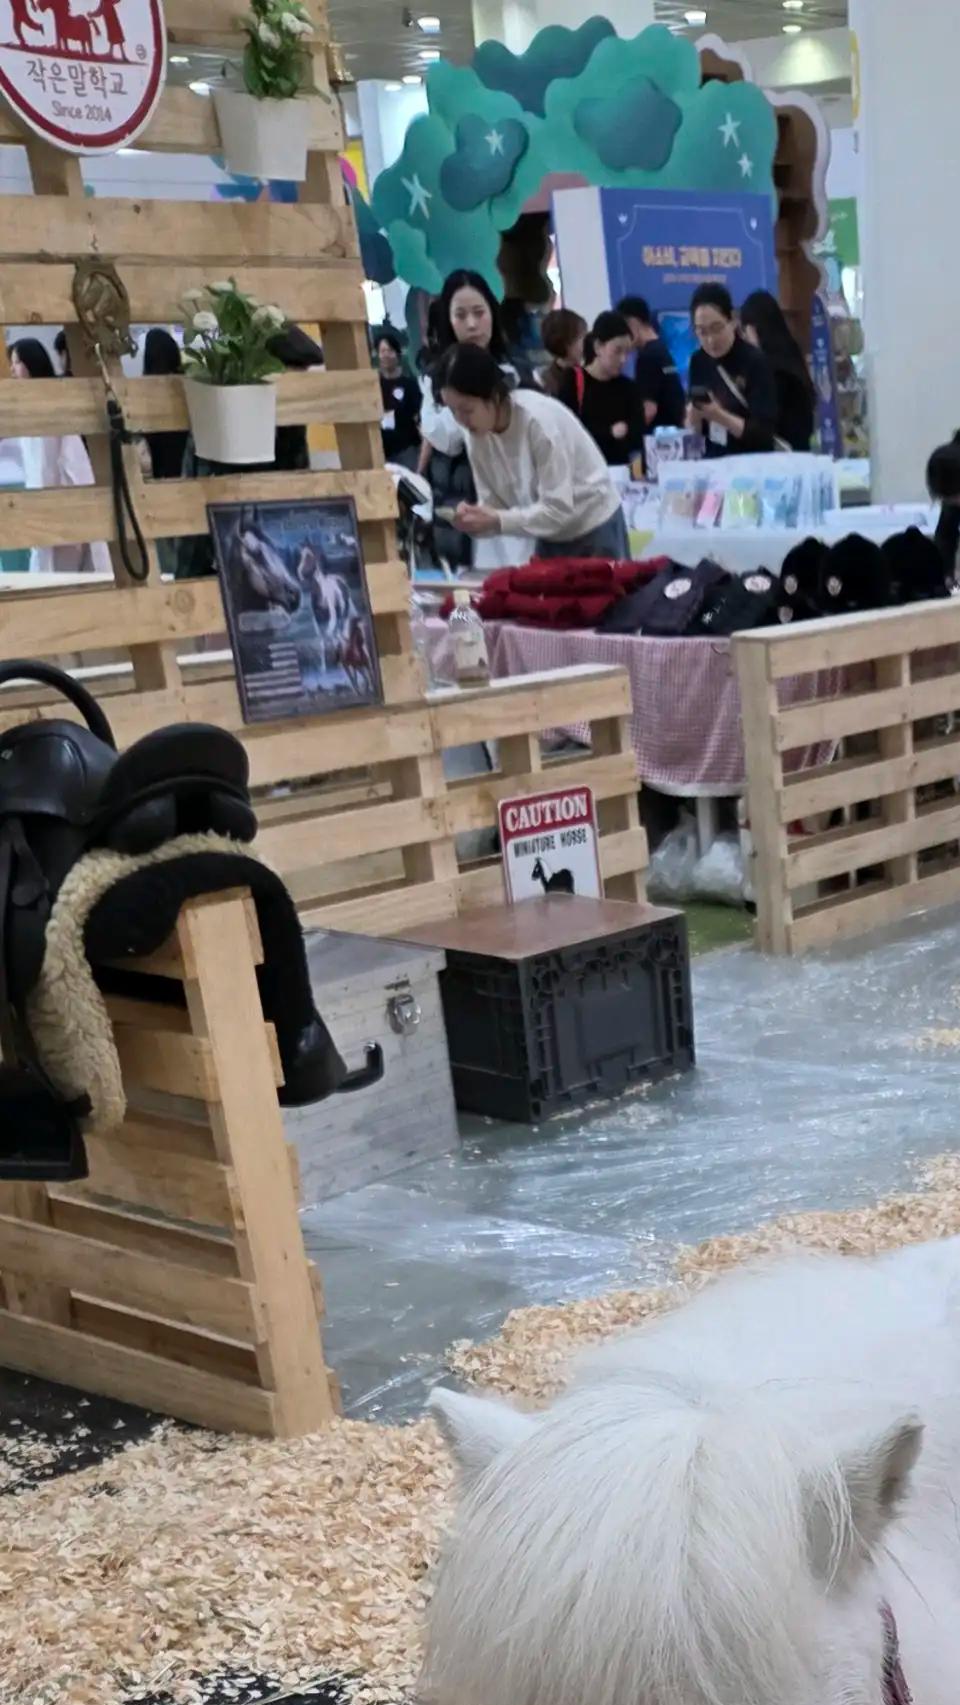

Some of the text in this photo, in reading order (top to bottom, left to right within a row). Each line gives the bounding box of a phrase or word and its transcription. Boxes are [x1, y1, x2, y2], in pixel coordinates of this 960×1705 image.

[26, 59, 127, 98] 작은말학교
[52, 101, 112, 122] Since 2014
[506, 793, 587, 832] CAUTION
[514, 828, 587, 858] MINIATURE HORSE
